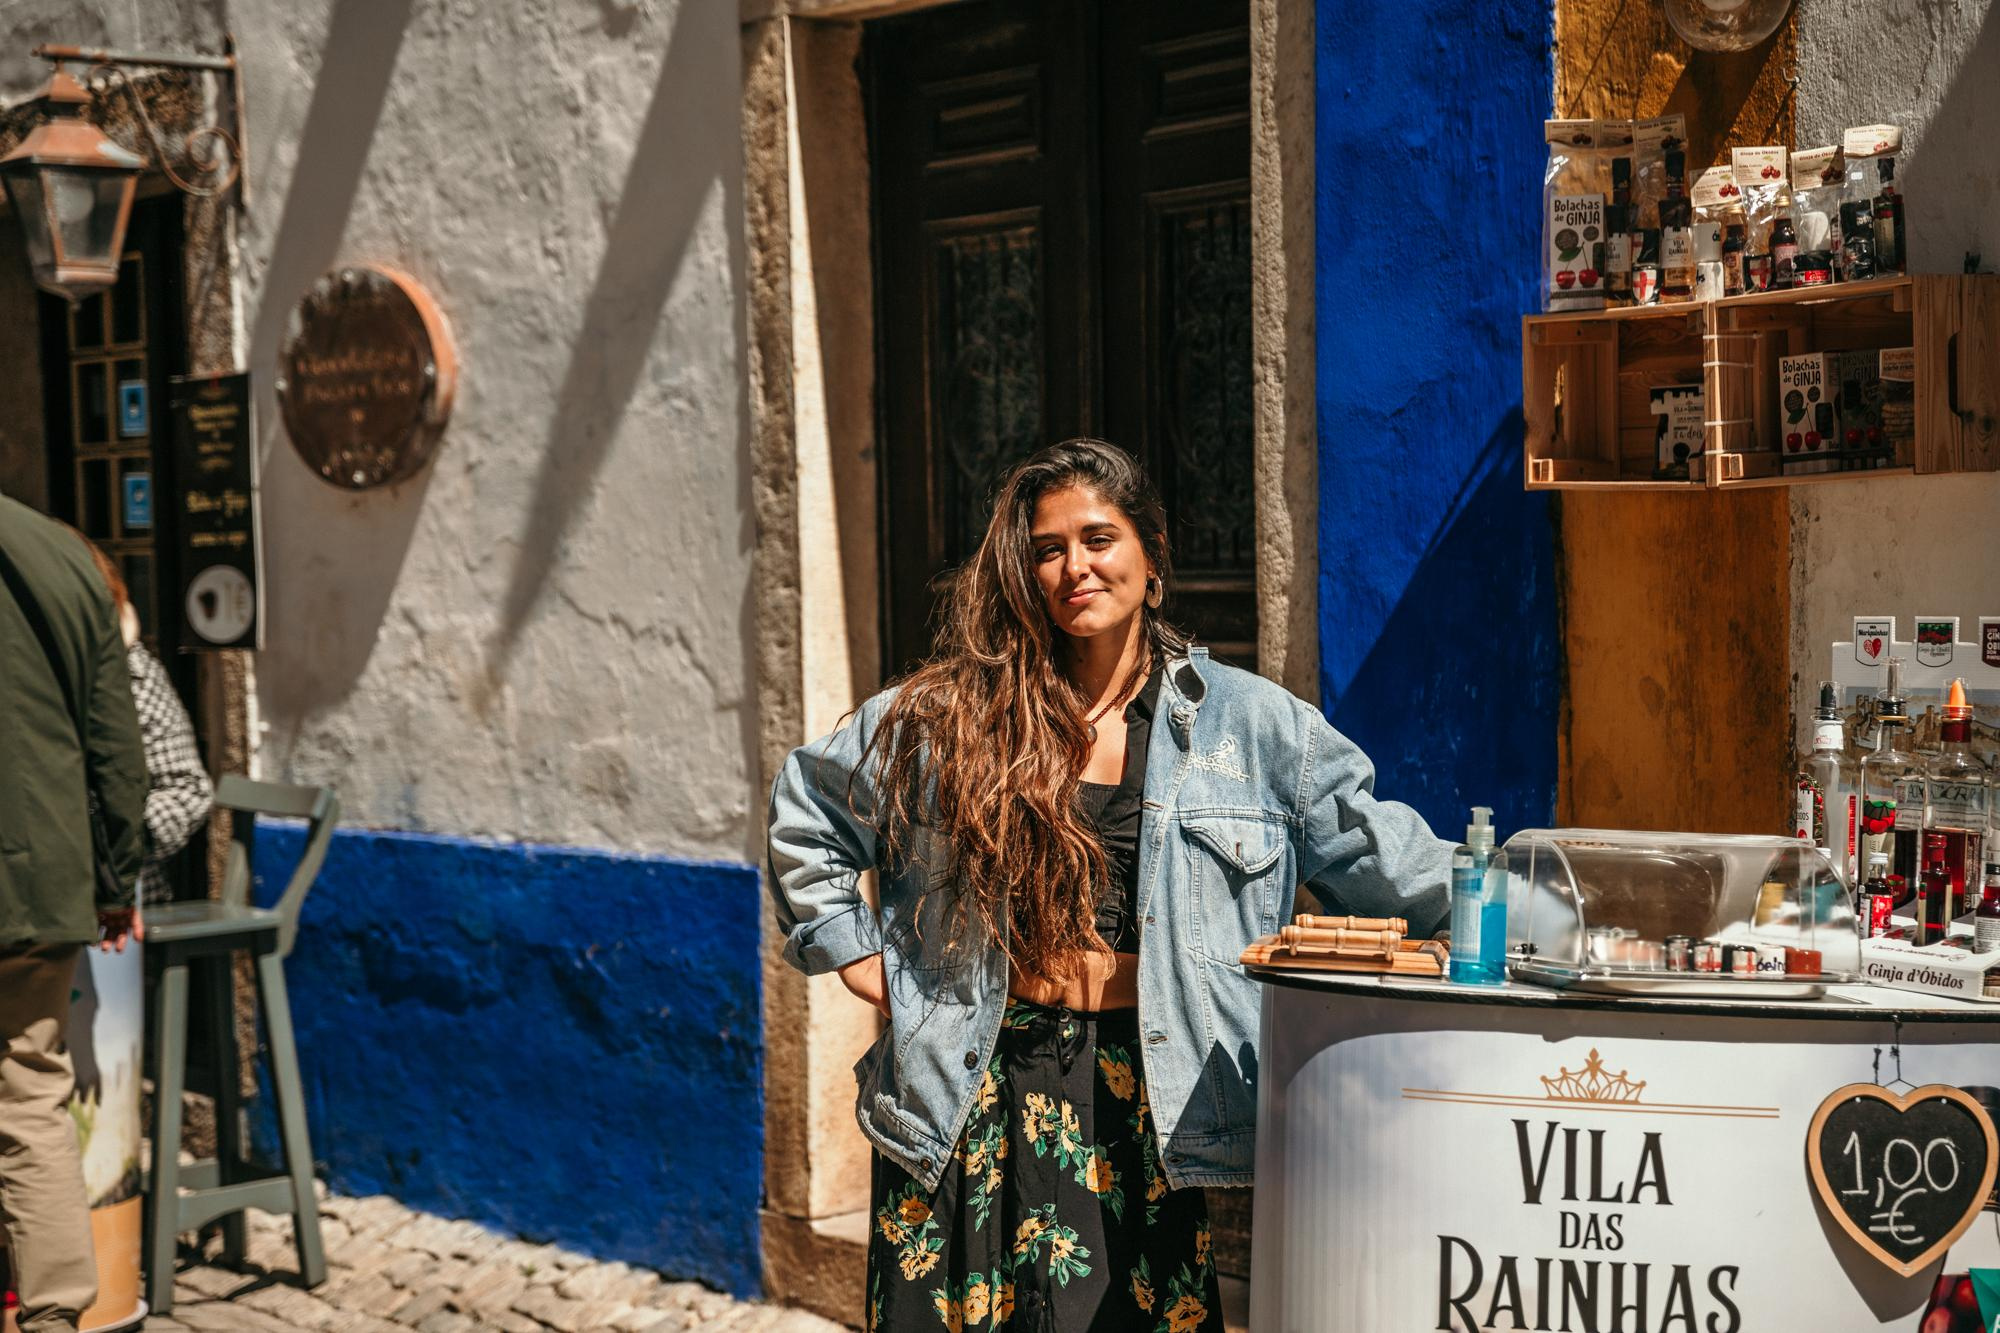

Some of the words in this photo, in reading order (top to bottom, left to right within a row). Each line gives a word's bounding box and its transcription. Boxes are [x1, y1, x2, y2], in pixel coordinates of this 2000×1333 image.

[1554, 199, 1600, 212] Bolachas
[1554, 214, 1564, 222] de
[1566, 211, 1600, 226] GINJA
[1782, 358, 1820, 373] Bolachas
[1783, 375, 1792, 383] de
[1793, 371, 1821, 387] GINJA
[1867, 962, 1903, 982] Ginja
[1906, 966, 1965, 990] d'Óbidos
[1511, 1118, 1674, 1206] VILA
[1841, 1130, 1960, 1208] 1,00
[1559, 1211, 1624, 1251] DAS
[1868, 1187, 1928, 1245] €
[1435, 1234, 1742, 1333] RAINHAS
